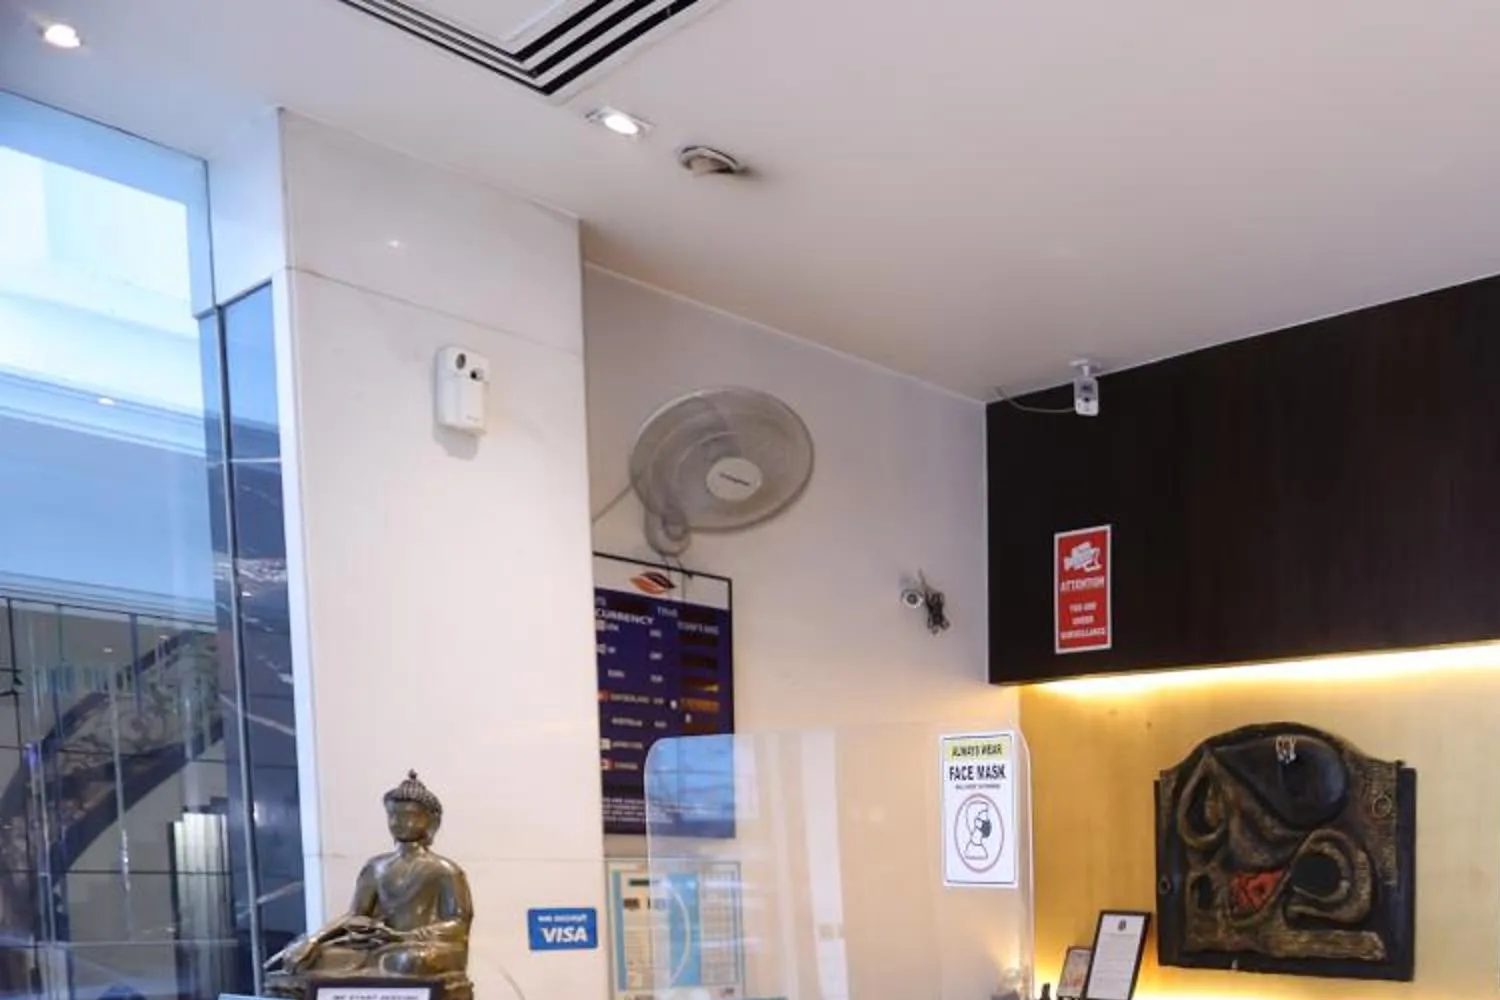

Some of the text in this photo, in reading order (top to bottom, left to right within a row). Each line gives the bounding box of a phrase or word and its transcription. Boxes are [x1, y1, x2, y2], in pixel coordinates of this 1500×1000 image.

[949, 763, 1006, 782] FACE MASK
[540, 925, 589, 943] VISA
